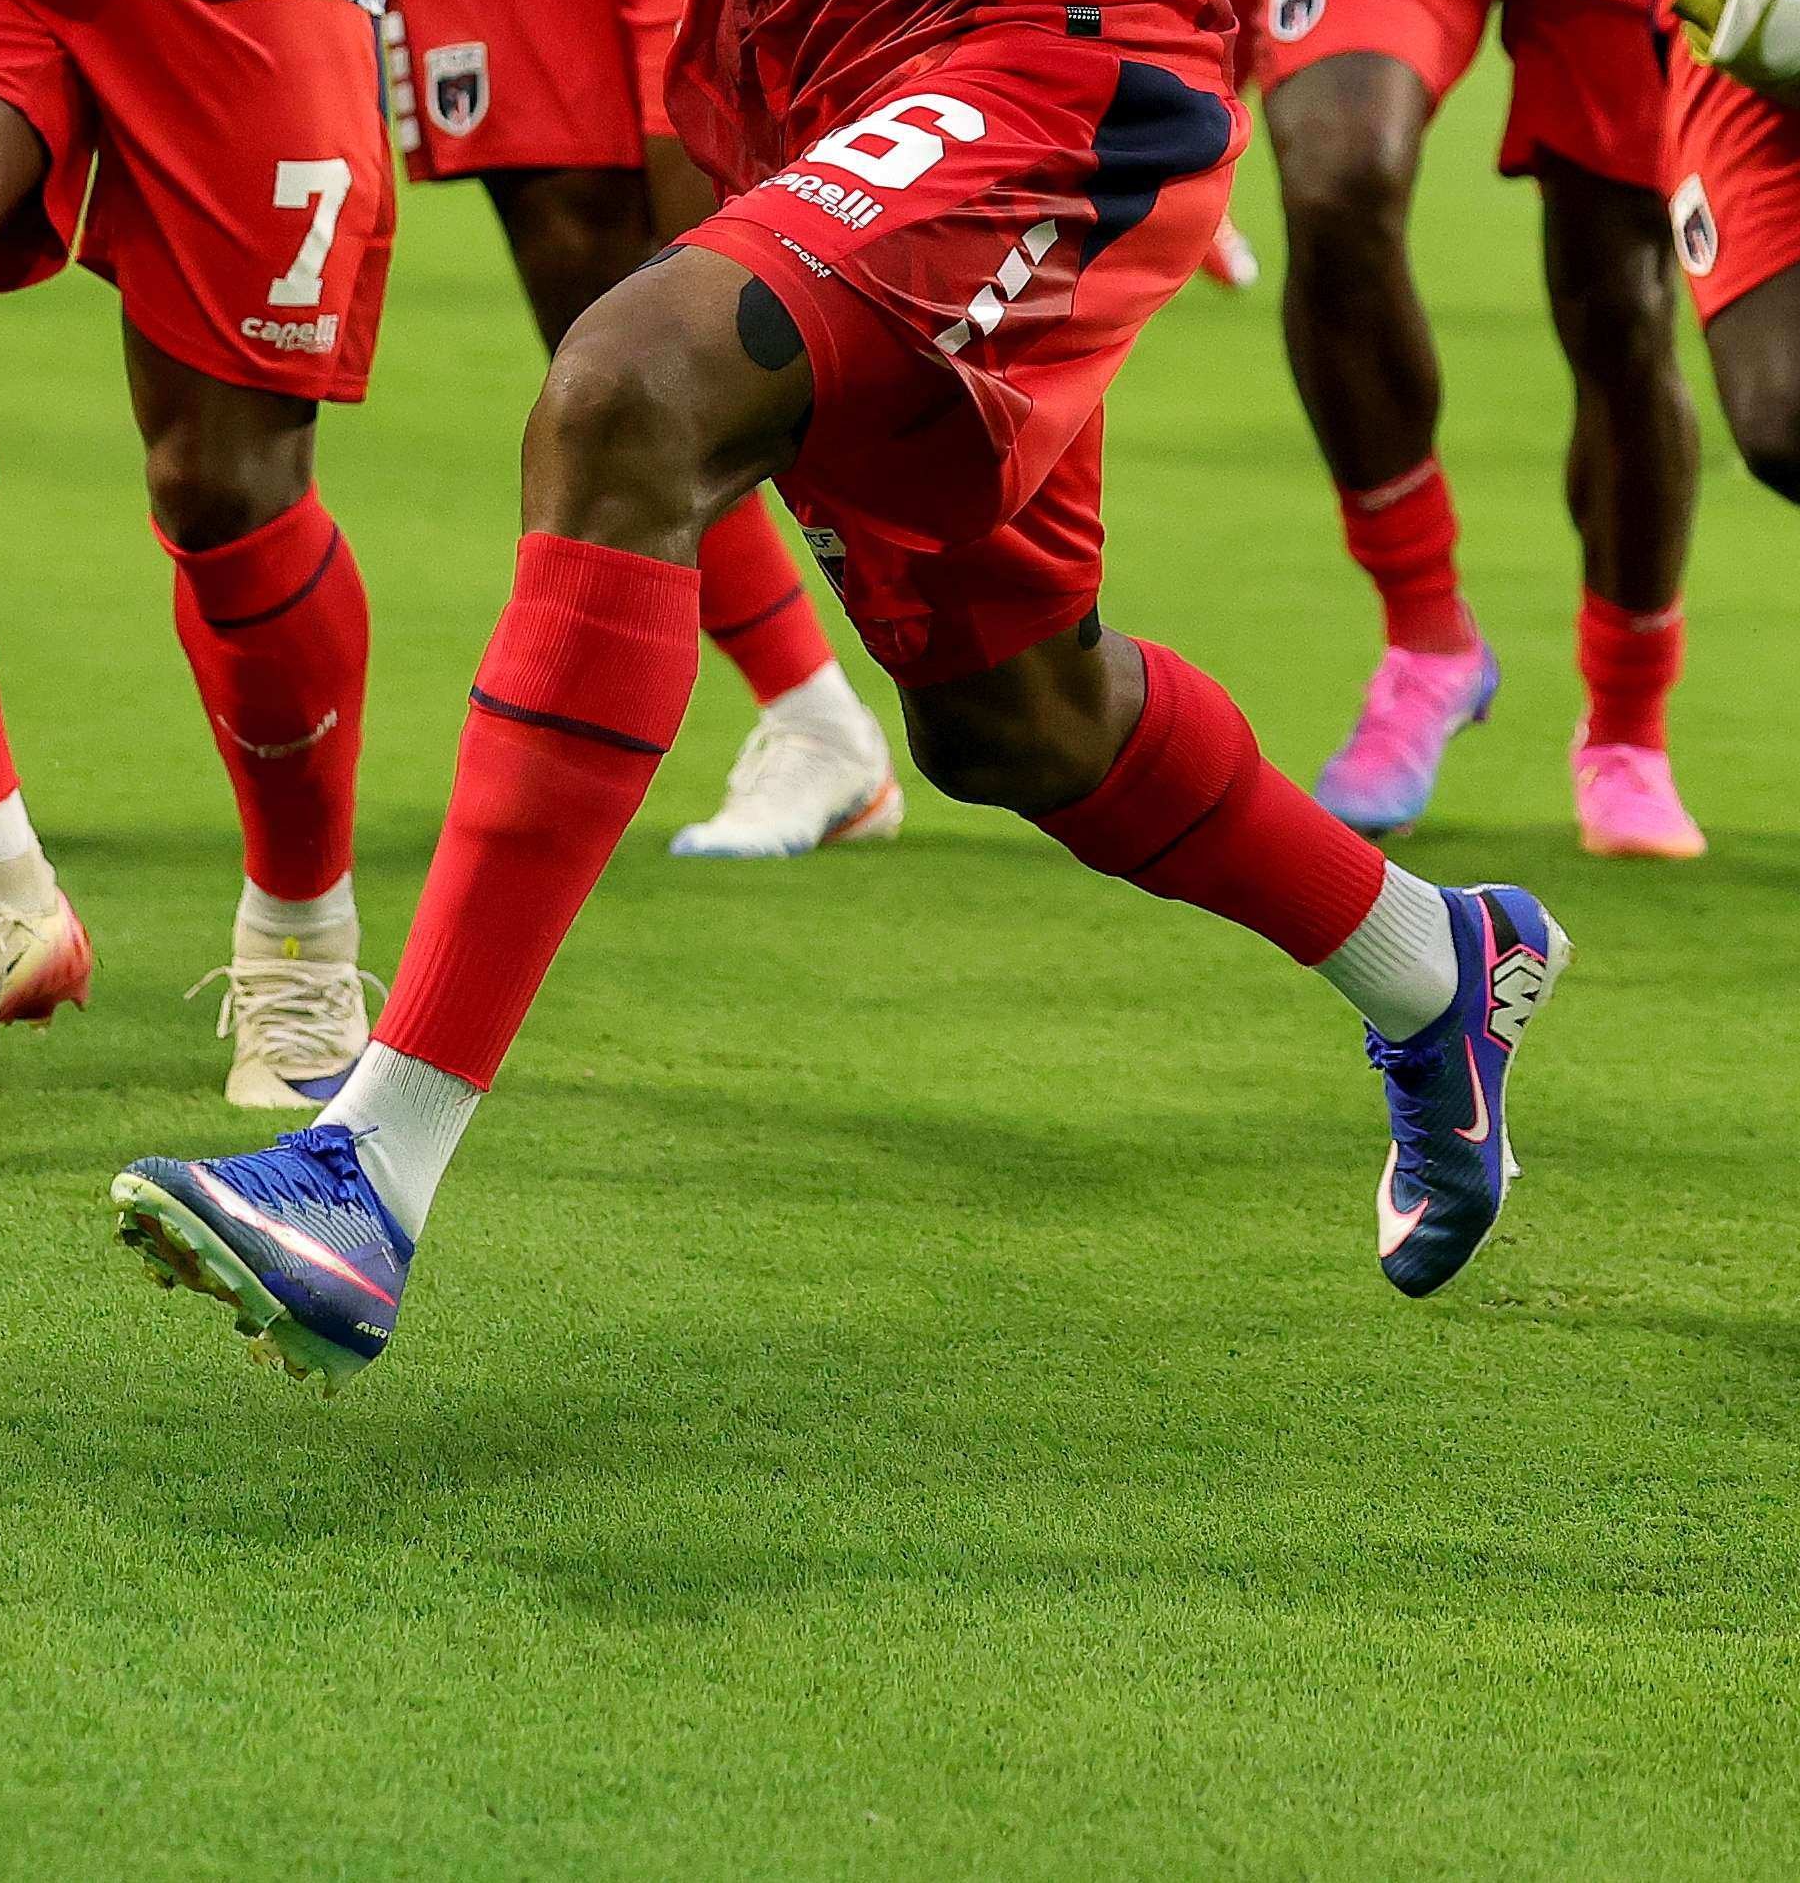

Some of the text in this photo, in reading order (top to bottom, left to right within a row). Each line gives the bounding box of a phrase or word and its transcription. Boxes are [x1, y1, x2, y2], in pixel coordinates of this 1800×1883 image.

[796, 189, 865, 231] SPORT
[268, 159, 353, 307] 7
[241, 313, 340, 352] capelli
